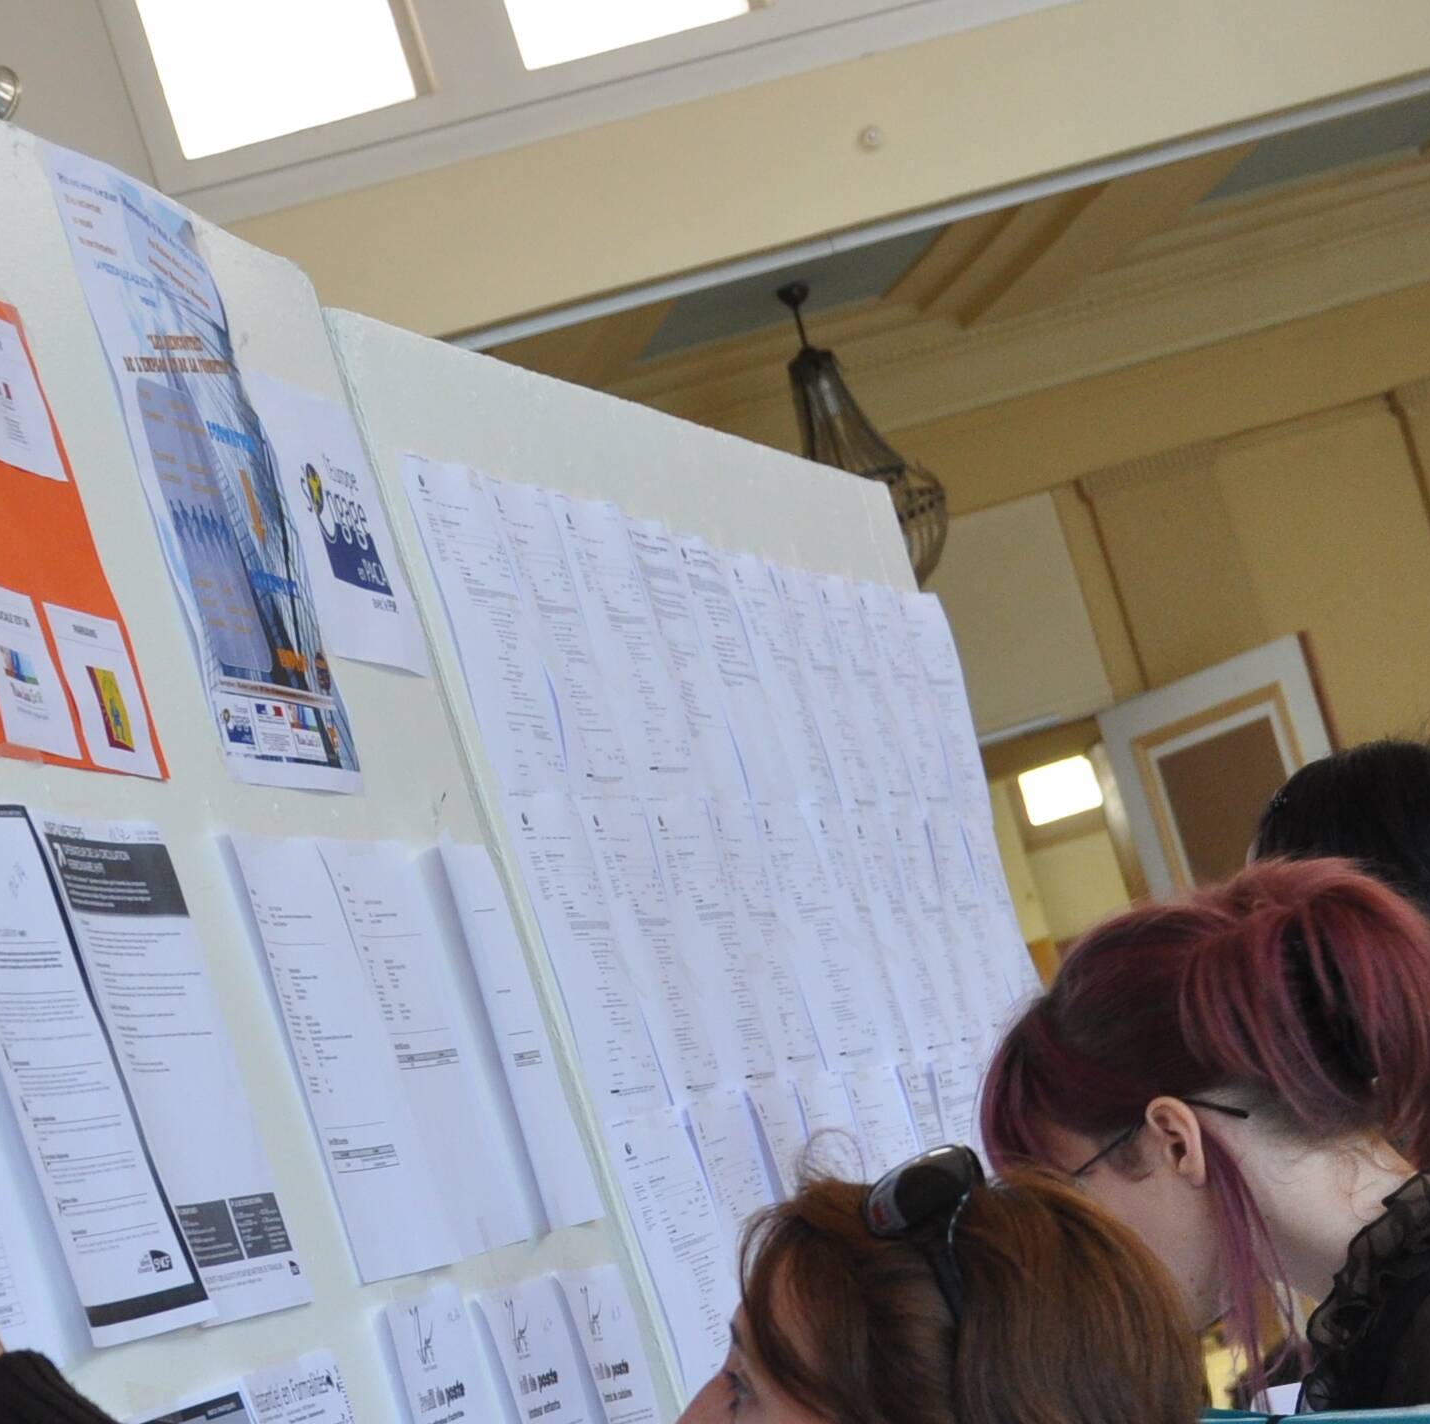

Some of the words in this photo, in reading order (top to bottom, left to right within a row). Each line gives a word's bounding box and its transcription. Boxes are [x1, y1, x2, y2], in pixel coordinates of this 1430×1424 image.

[537, 1367, 559, 1394] poste
[611, 1358, 630, 1382] poste
[444, 1379, 466, 1408] poste
